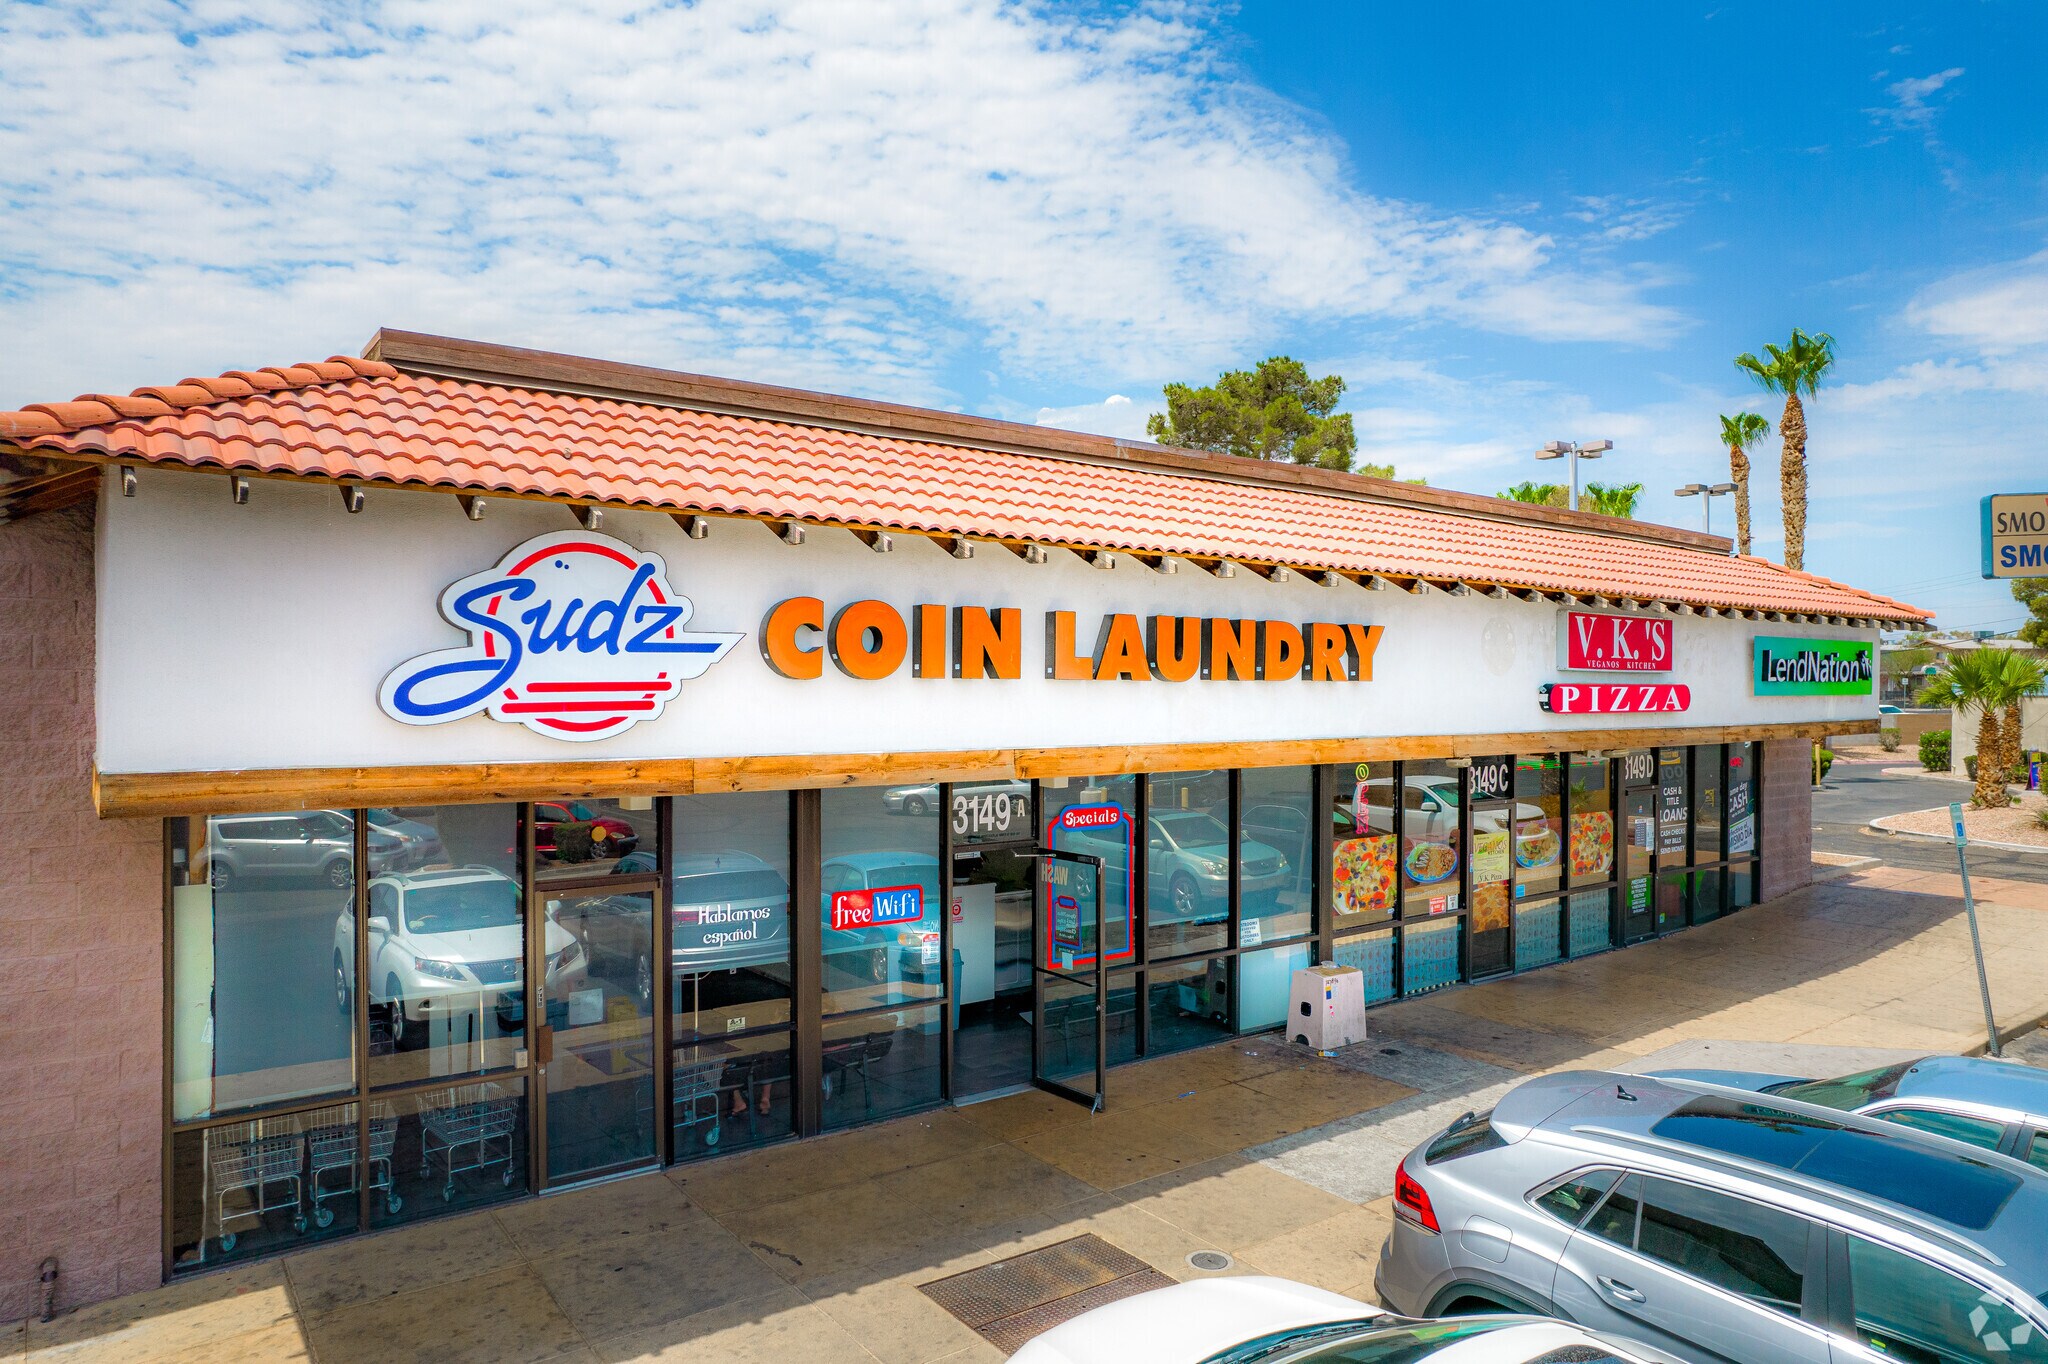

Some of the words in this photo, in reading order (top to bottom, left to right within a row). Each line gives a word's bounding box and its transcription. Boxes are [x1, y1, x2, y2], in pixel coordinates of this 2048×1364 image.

[2000, 544, 2048, 568] SM
[393, 562, 724, 717] Sudz
[760, 596, 1022, 680] COIN
[1047, 611, 1385, 682] LAUNDRY
[1575, 615, 1666, 661] V.K.'S
[1587, 659, 1619, 669] VEGANOS
[1626, 660, 1656, 670] KITCHEN
[1766, 649, 1859, 683] LendNation
[1559, 686, 1682, 713] PIZZA
[1499, 764, 1508, 792] C
[1646, 754, 1654, 778] D
[1663, 787, 1677, 796] CASH
[952, 793, 1011, 834] 3149
[1017, 798, 1026, 818] A
[1065, 809, 1118, 827] Specials
[1660, 807, 1688, 823] LOANS
[698, 903, 771, 925] Hablamos
[834, 896, 872, 928] free
[876, 892, 916, 917] Wifi
[703, 921, 757, 947] español
